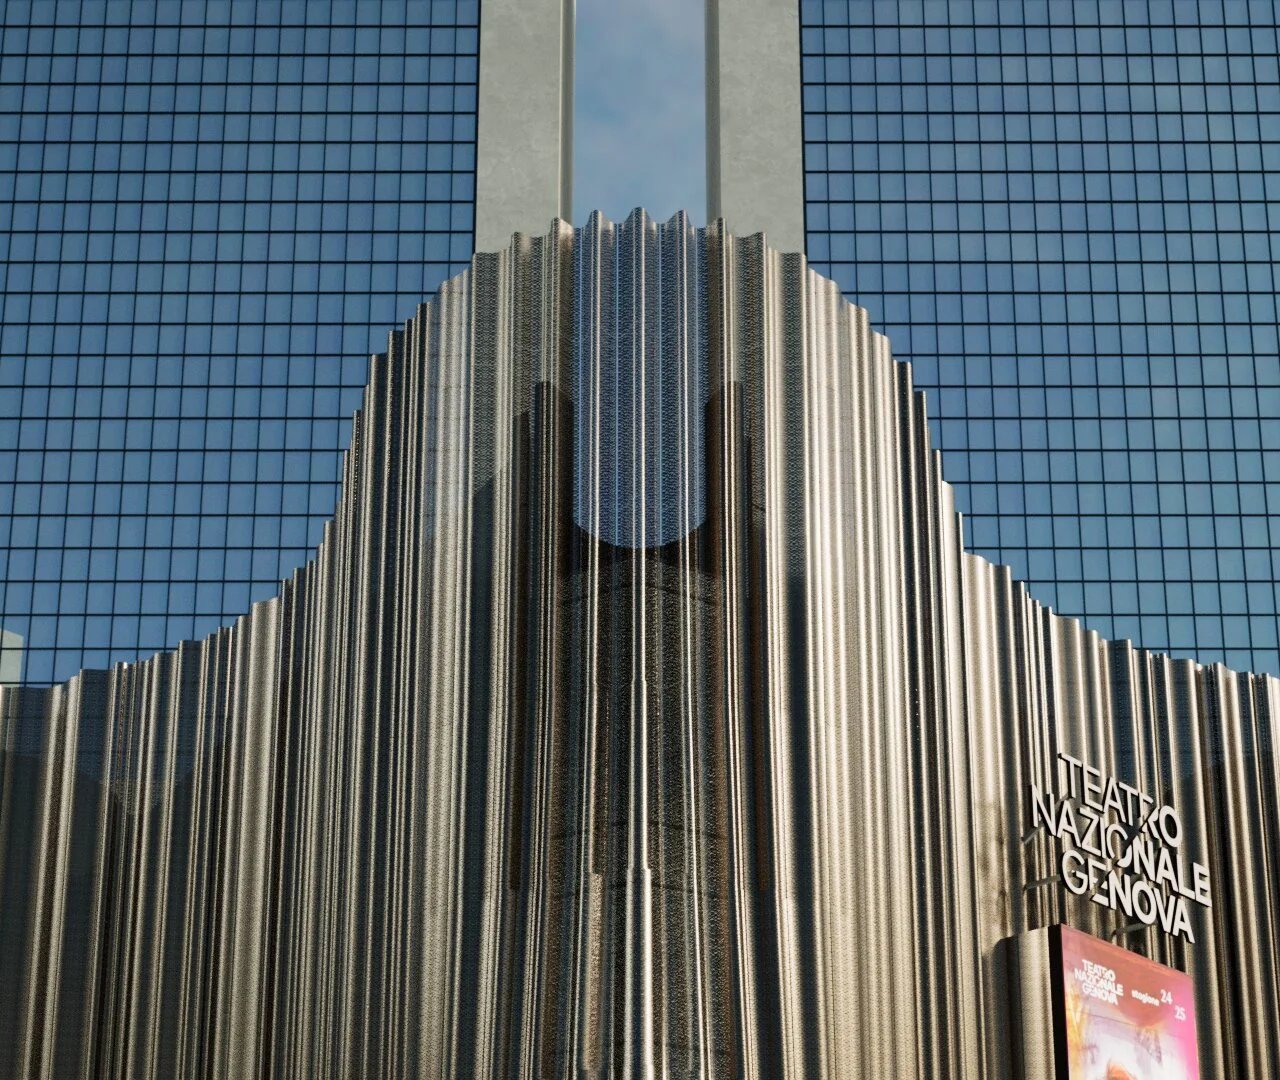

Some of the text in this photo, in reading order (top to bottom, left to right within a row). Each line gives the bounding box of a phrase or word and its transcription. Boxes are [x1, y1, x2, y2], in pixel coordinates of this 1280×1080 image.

[1059, 753, 1183, 848] TEATRO
[1031, 784, 1212, 907] NAZIONALE
[1061, 850, 1195, 943] GENOVA
[1081, 959, 1116, 982] TEATRO
[1160, 988, 1173, 1005] 24
[1174, 1004, 1187, 1021] 25
